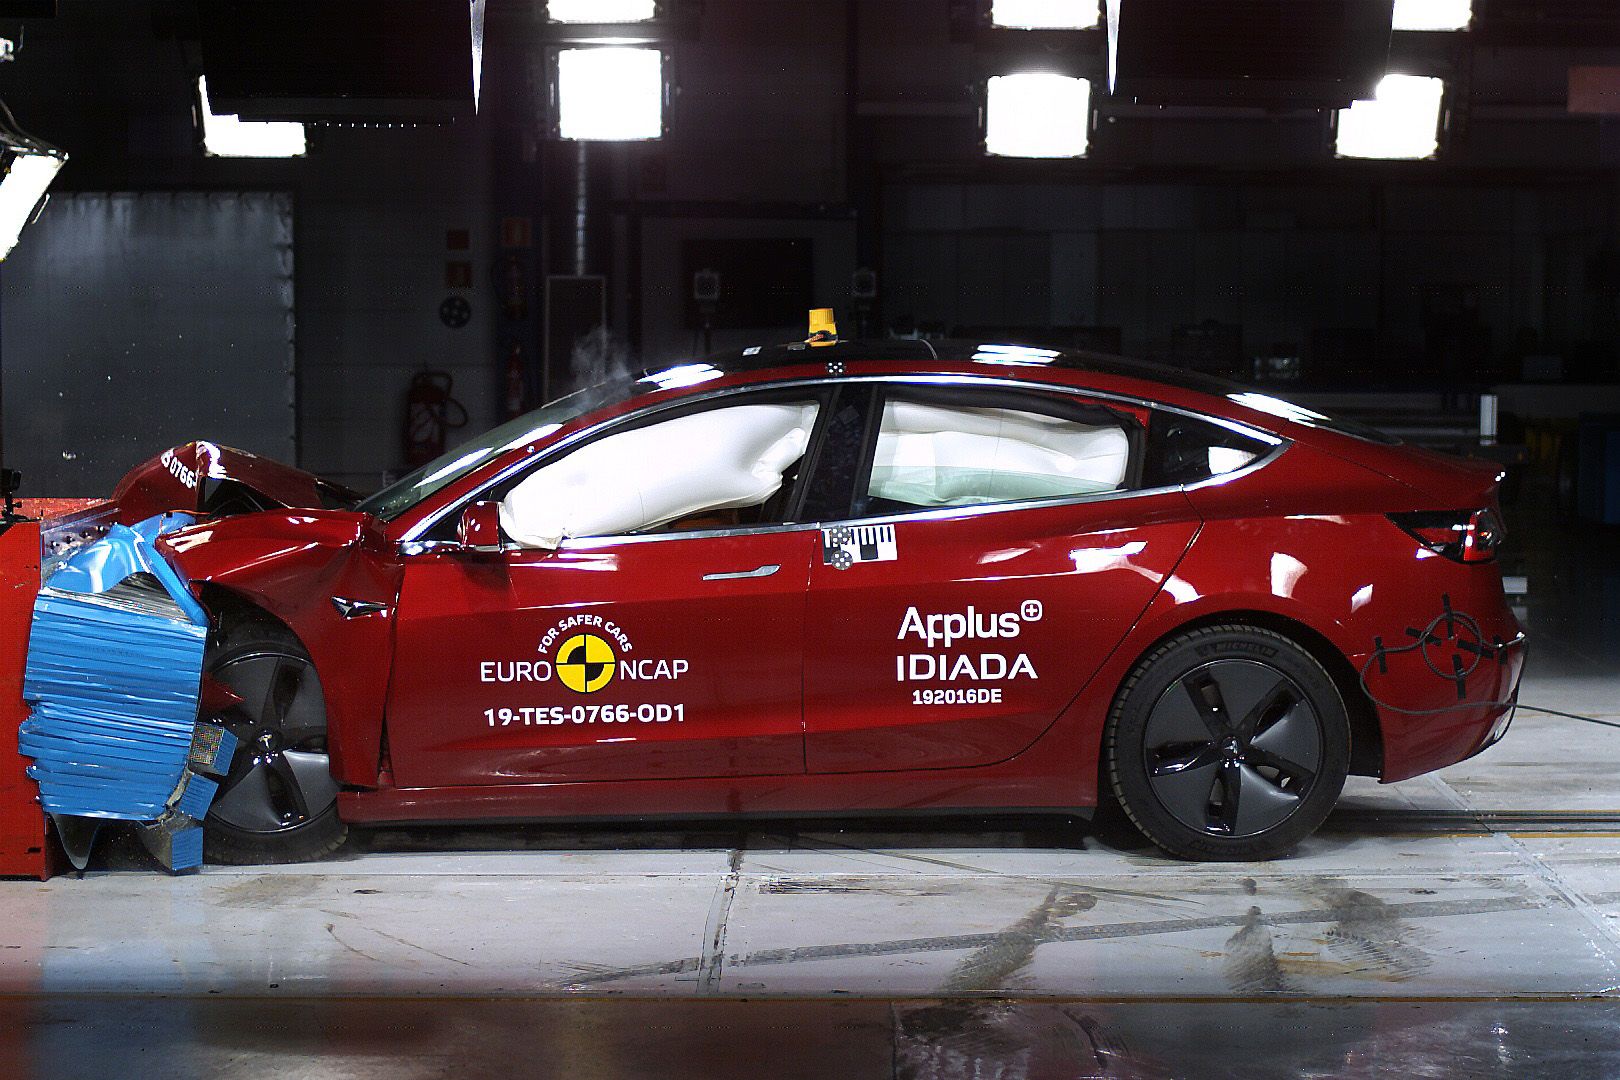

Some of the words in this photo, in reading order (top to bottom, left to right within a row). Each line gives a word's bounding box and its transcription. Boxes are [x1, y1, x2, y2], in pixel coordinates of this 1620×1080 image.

[537, 626, 559, 654] FOR
[558, 614, 602, 632] SAFER
[604, 621, 633, 653] CARS
[897, 605, 1020, 648] Applus
[480, 661, 552, 682] EURO
[620, 659, 689, 680] NCAP
[896, 653, 1039, 682] IDIADA
[912, 688, 1002, 705] 192016DE
[484, 703, 684, 727] 19-TES-0766-OD1
